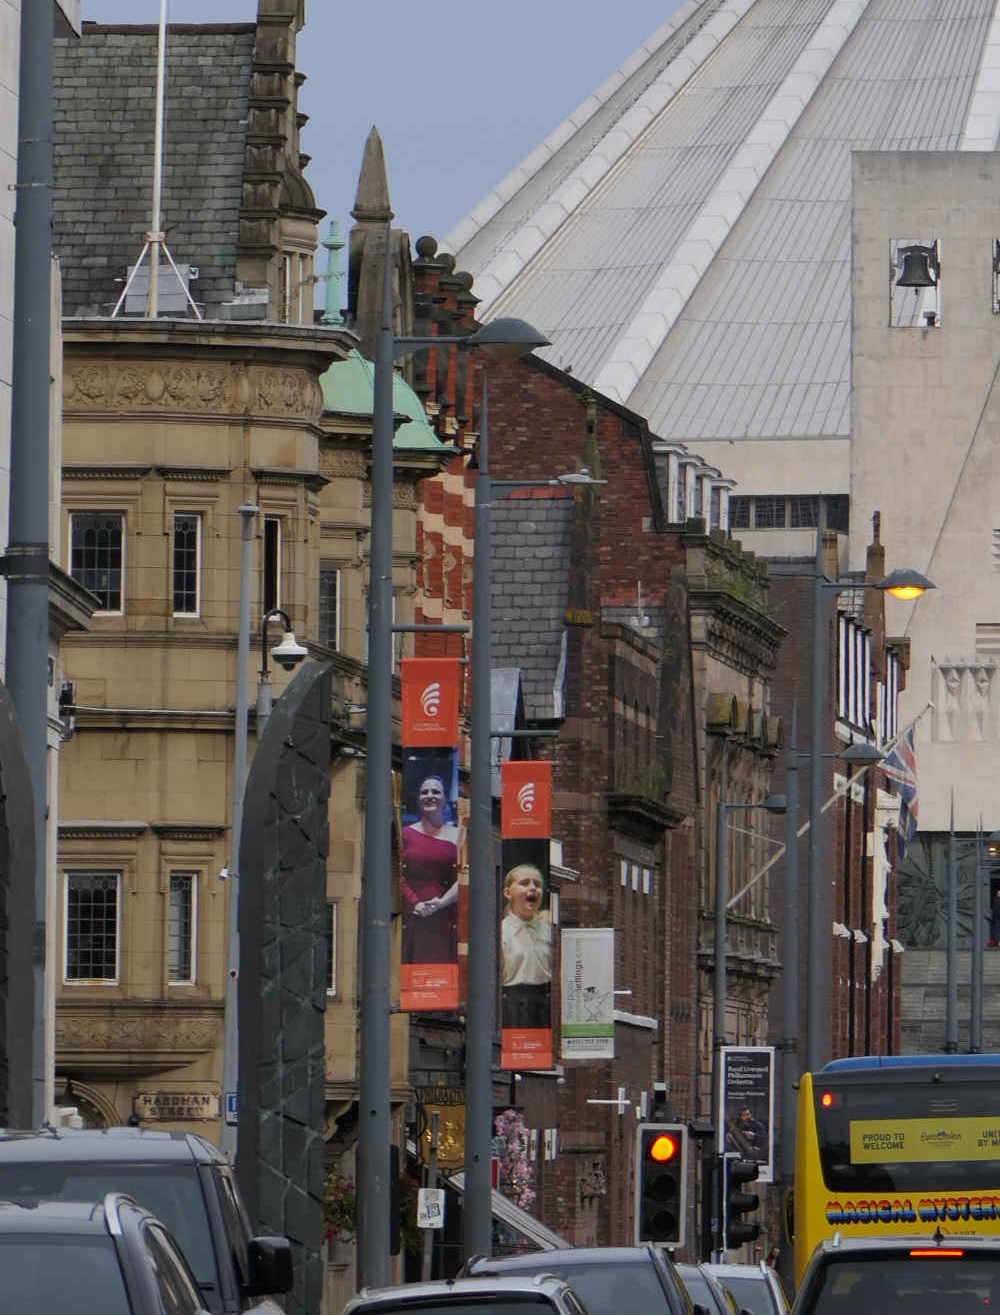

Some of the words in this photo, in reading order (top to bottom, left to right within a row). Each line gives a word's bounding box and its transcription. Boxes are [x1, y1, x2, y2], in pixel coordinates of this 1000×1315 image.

[143, 1096, 210, 1106] HARDMAN
[150, 1107, 205, 1117] STREET
[862, 1133, 892, 1142] PROUD
[894, 1132, 905, 1141] TO
[863, 1141, 905, 1150] WELCOME
[977, 1139, 989, 1147] BY
[825, 1199, 917, 1226] MAGICAL
